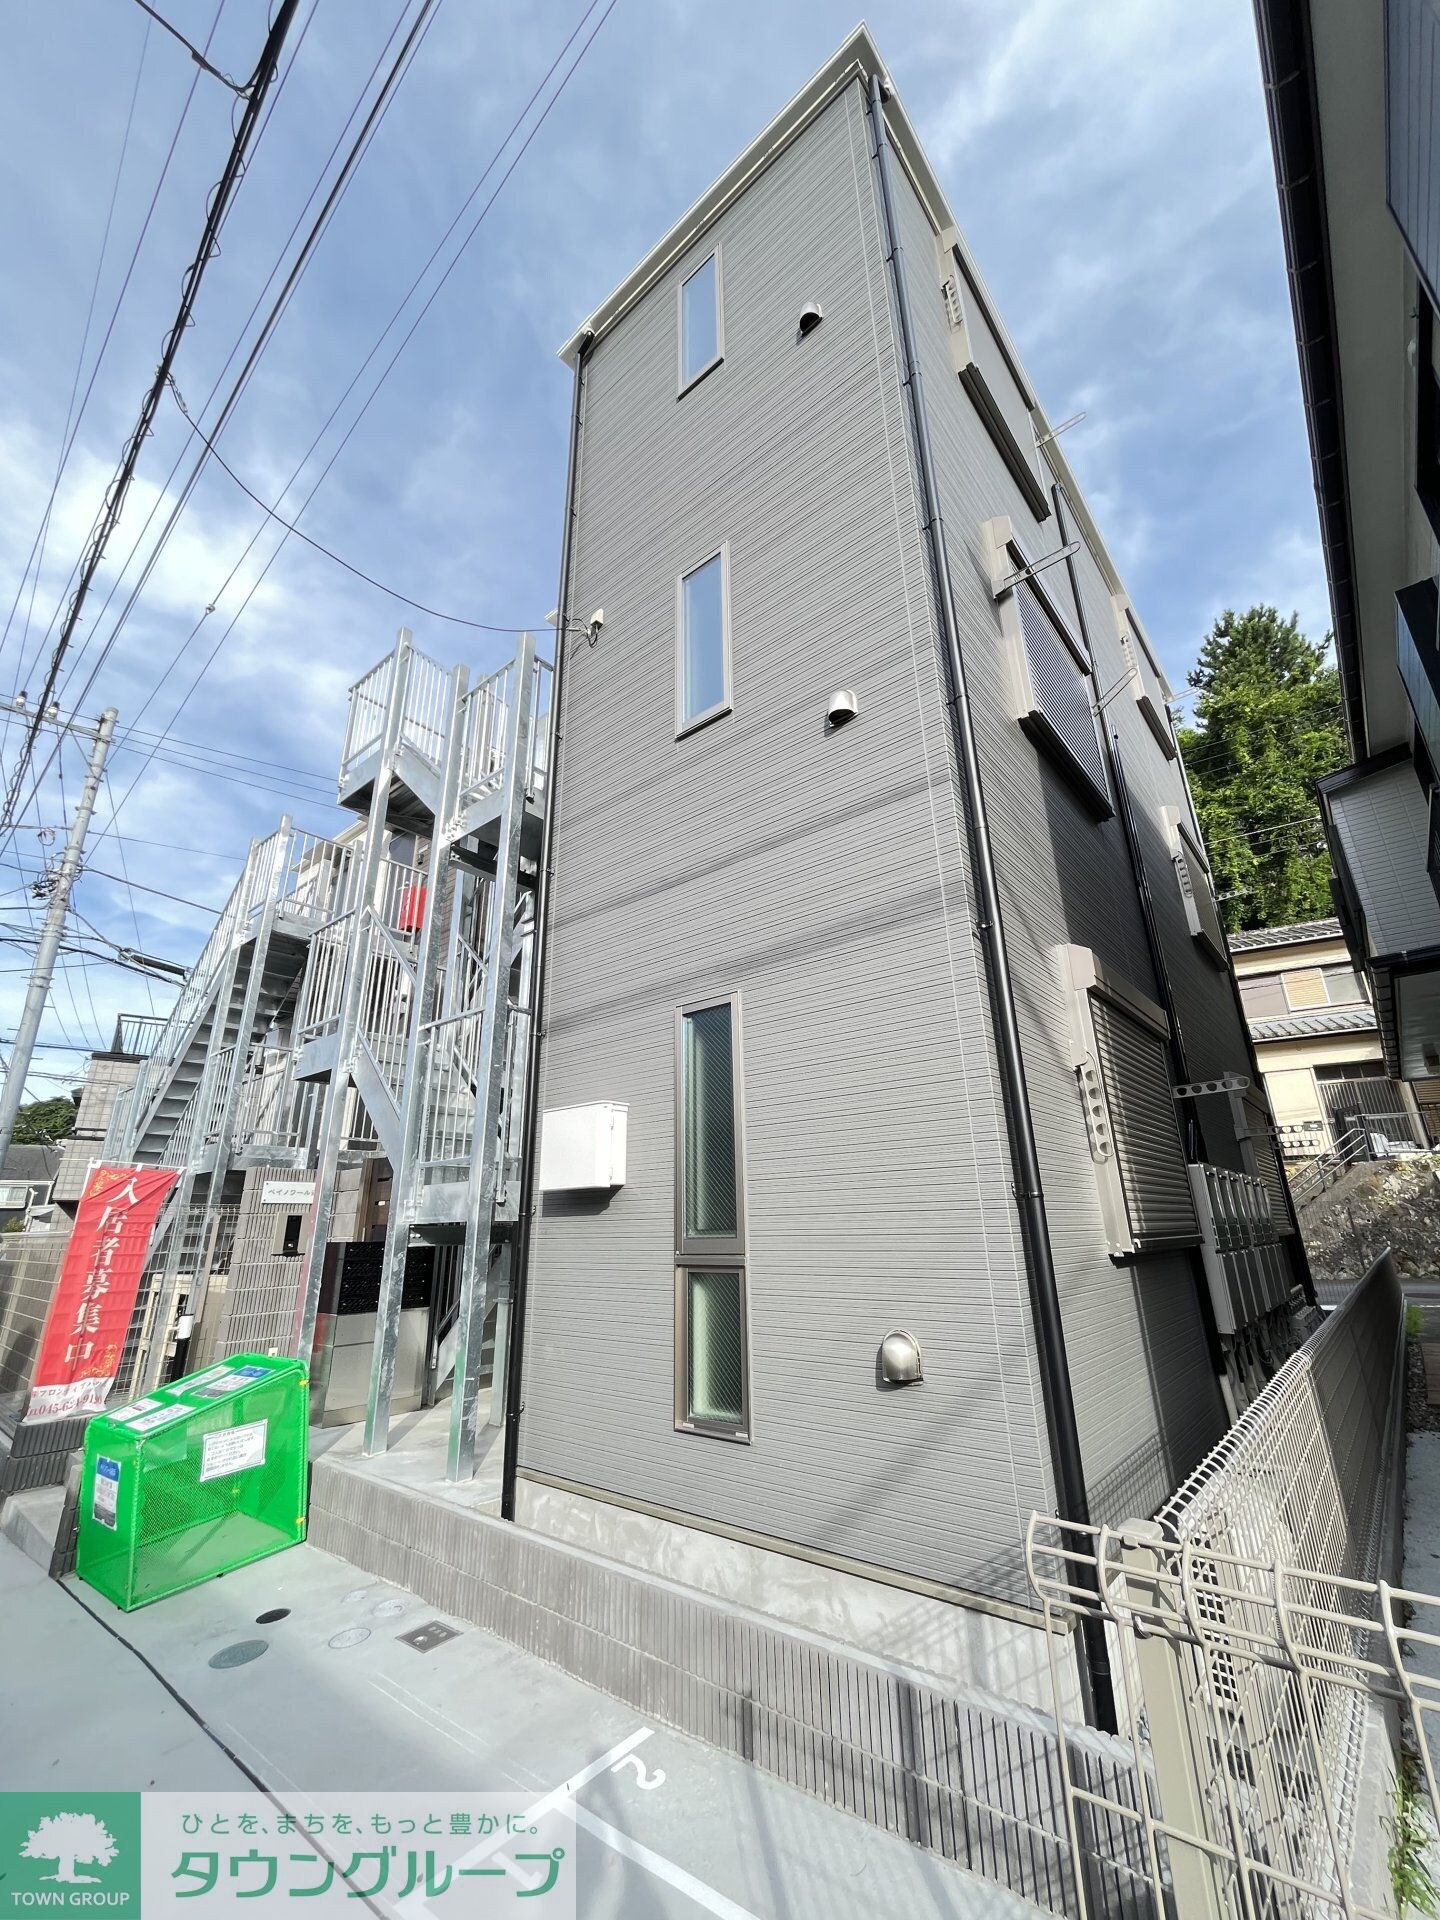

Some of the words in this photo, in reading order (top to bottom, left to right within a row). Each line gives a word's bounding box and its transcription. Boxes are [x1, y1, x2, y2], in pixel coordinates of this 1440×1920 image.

[64, 1176, 139, 1371] 入居者募集中
